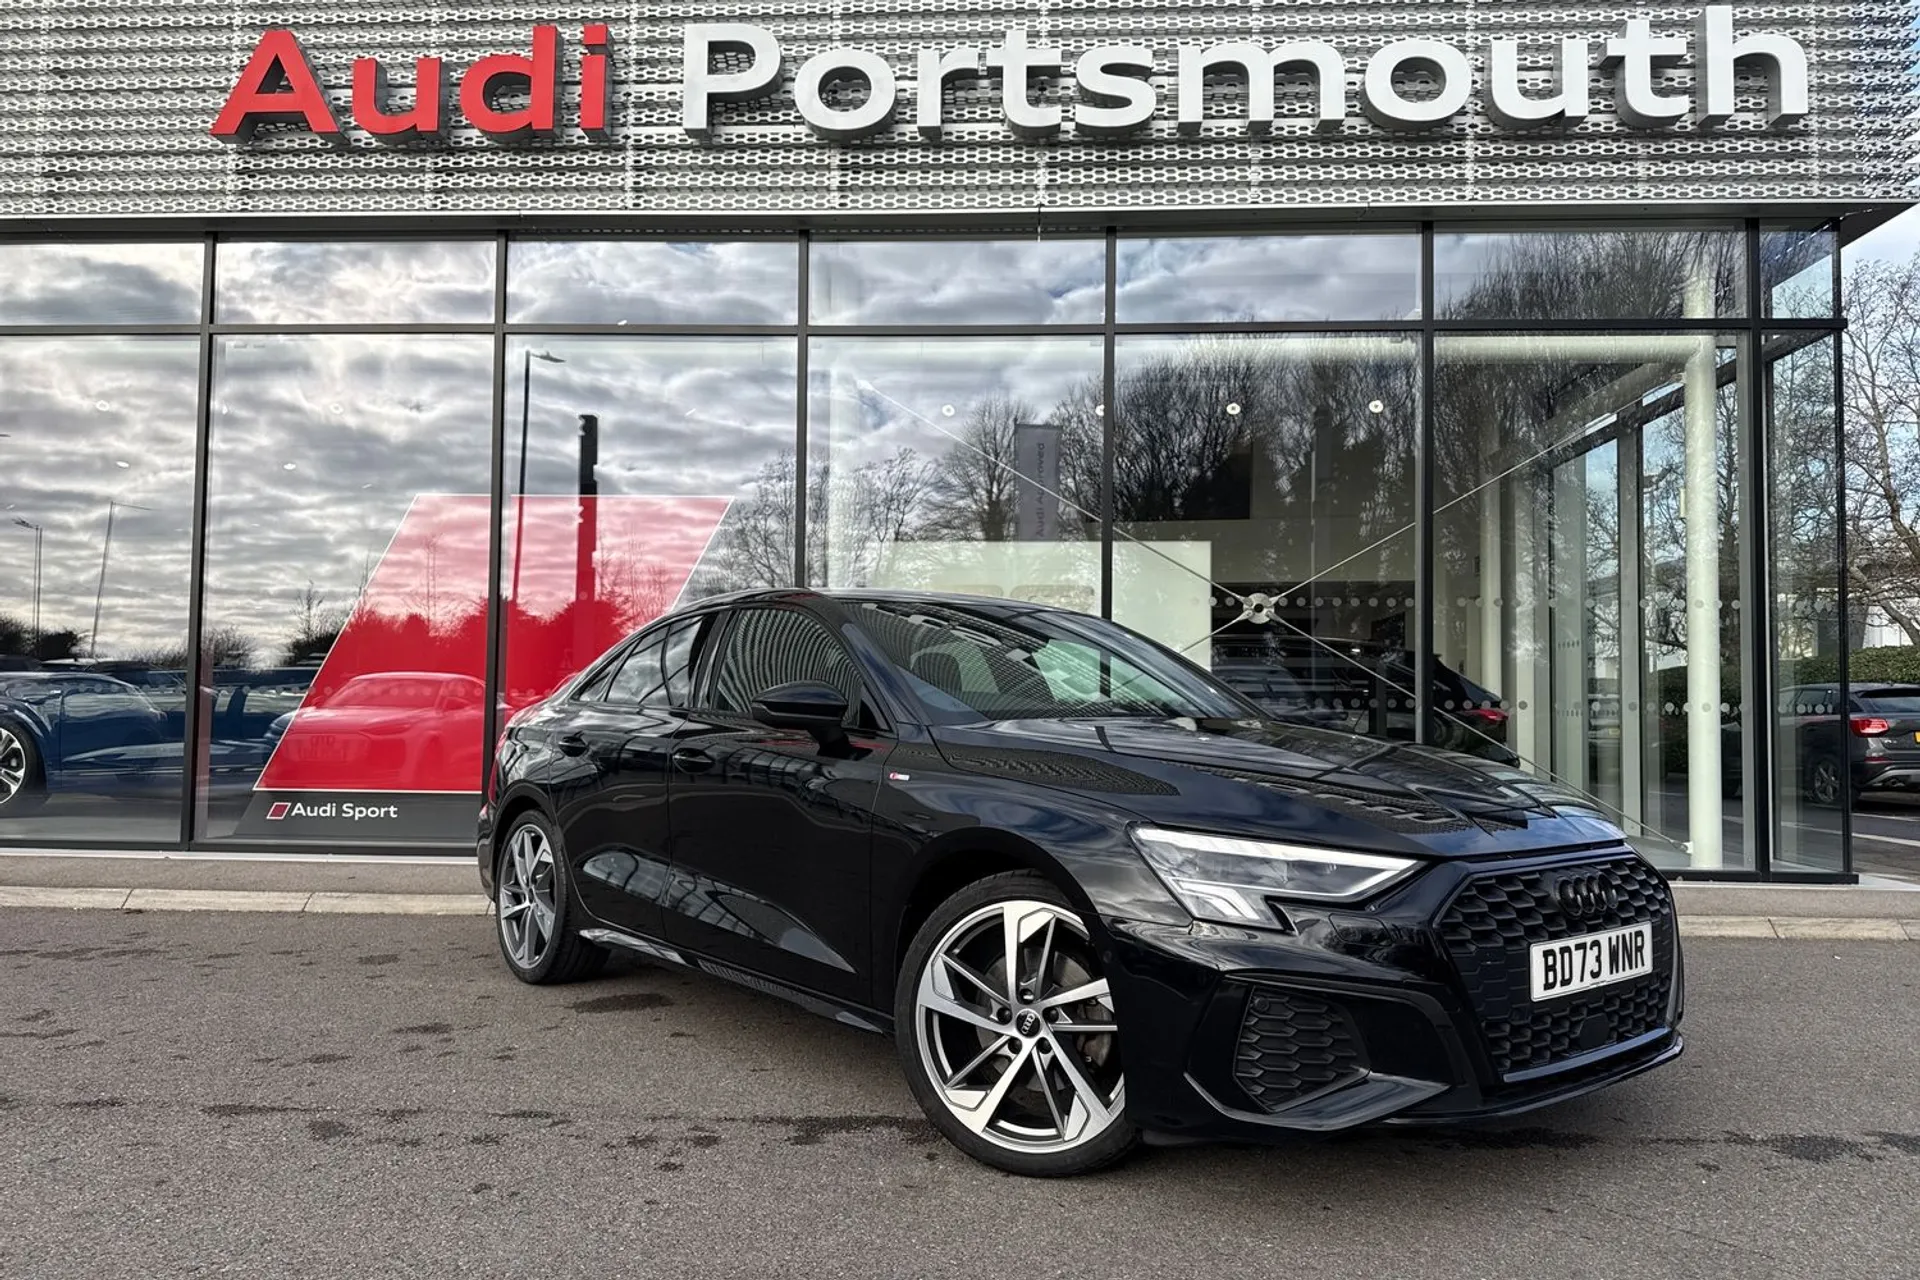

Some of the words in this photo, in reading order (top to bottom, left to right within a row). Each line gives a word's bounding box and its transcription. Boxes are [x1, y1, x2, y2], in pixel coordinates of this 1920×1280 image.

[210, 24, 609, 136] Audi
[683, 5, 1809, 133] Portsmouth
[1035, 507, 1045, 537] Audi
[290, 802, 337, 817] Audi
[341, 802, 398, 821] Sport
[1542, 939, 1602, 991] BD73
[1608, 930, 1645, 975] WNR
